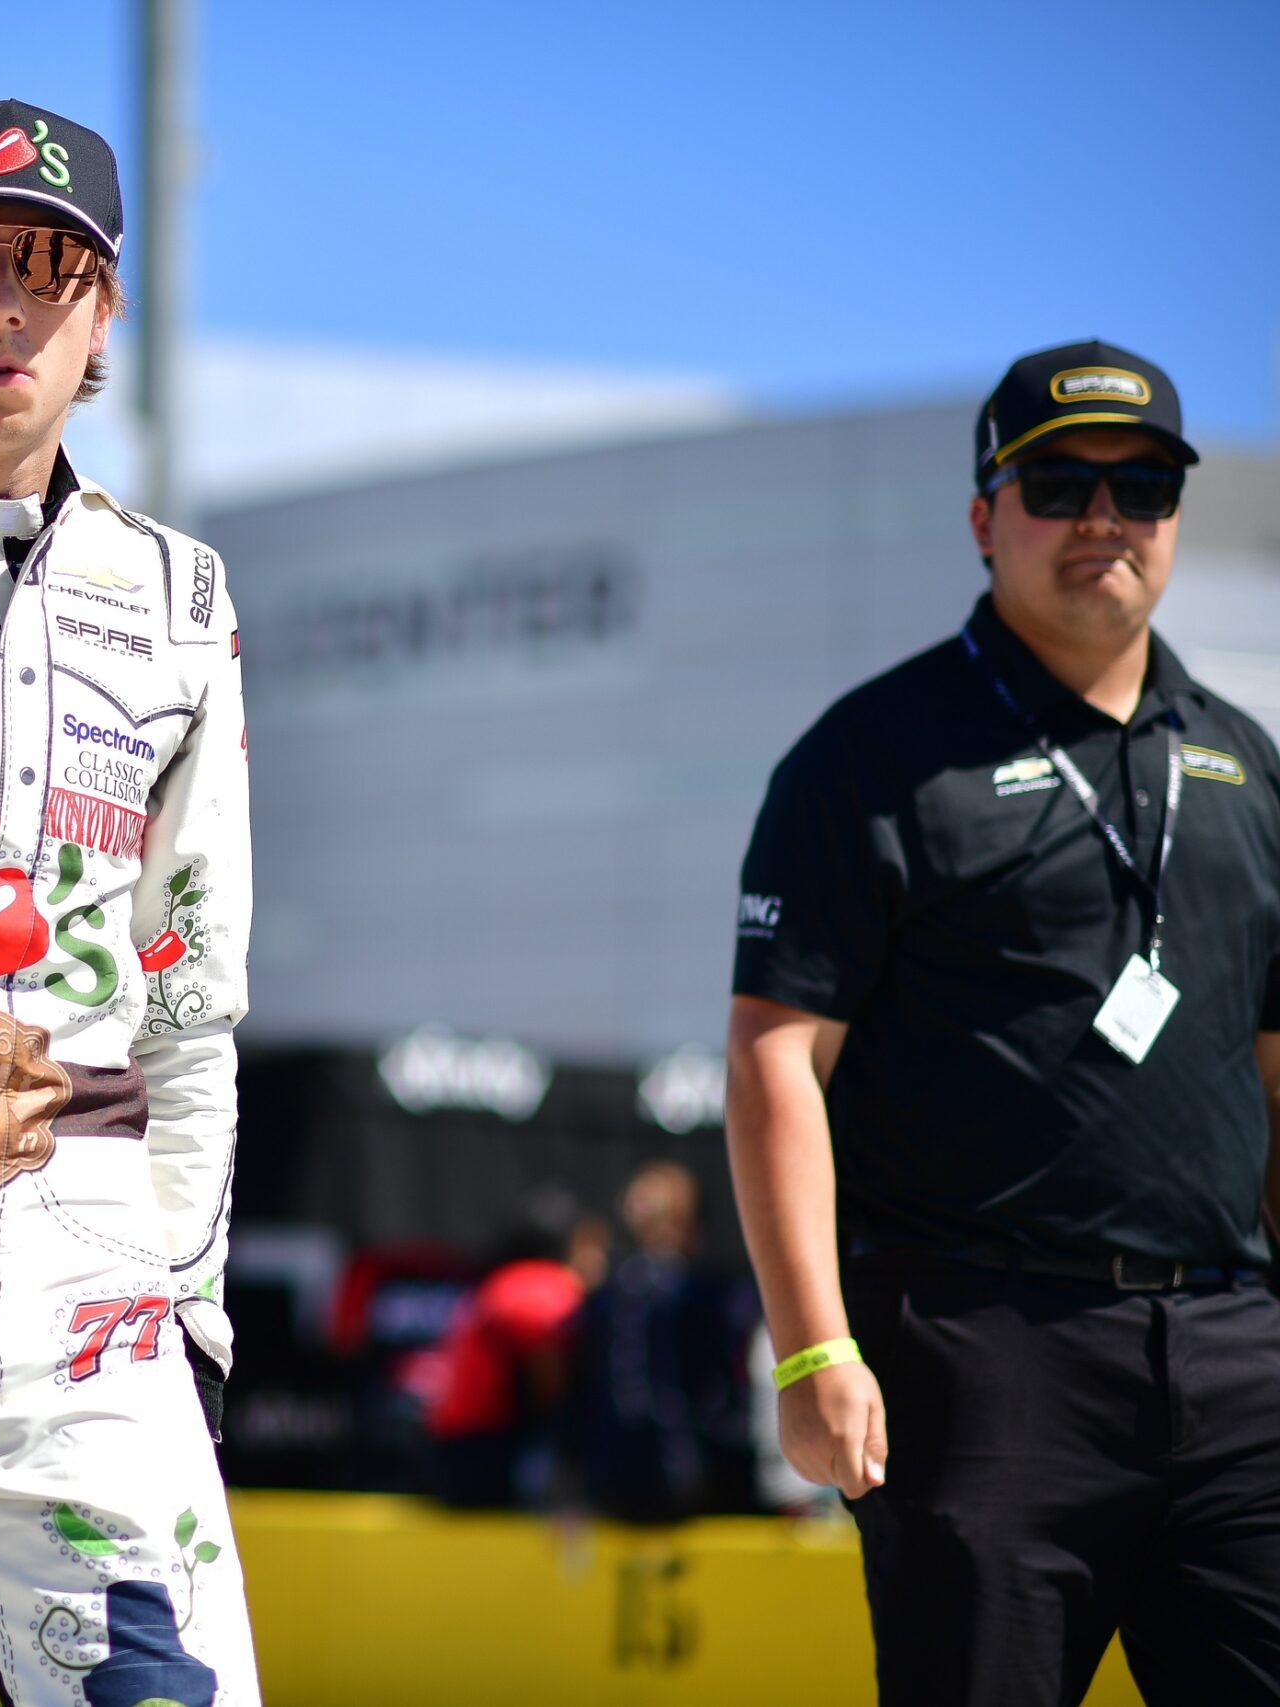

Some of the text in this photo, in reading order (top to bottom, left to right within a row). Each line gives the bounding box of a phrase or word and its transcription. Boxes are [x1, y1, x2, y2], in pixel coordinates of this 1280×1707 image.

[48, 584, 151, 615] CHEVROLET
[190, 547, 215, 629] sparco
[63, 713, 150, 759] Spectrum
[64, 766, 144, 805] COLLISION
[79, 751, 144, 786] CLASSIC
[68, 1294, 170, 1382] 77
